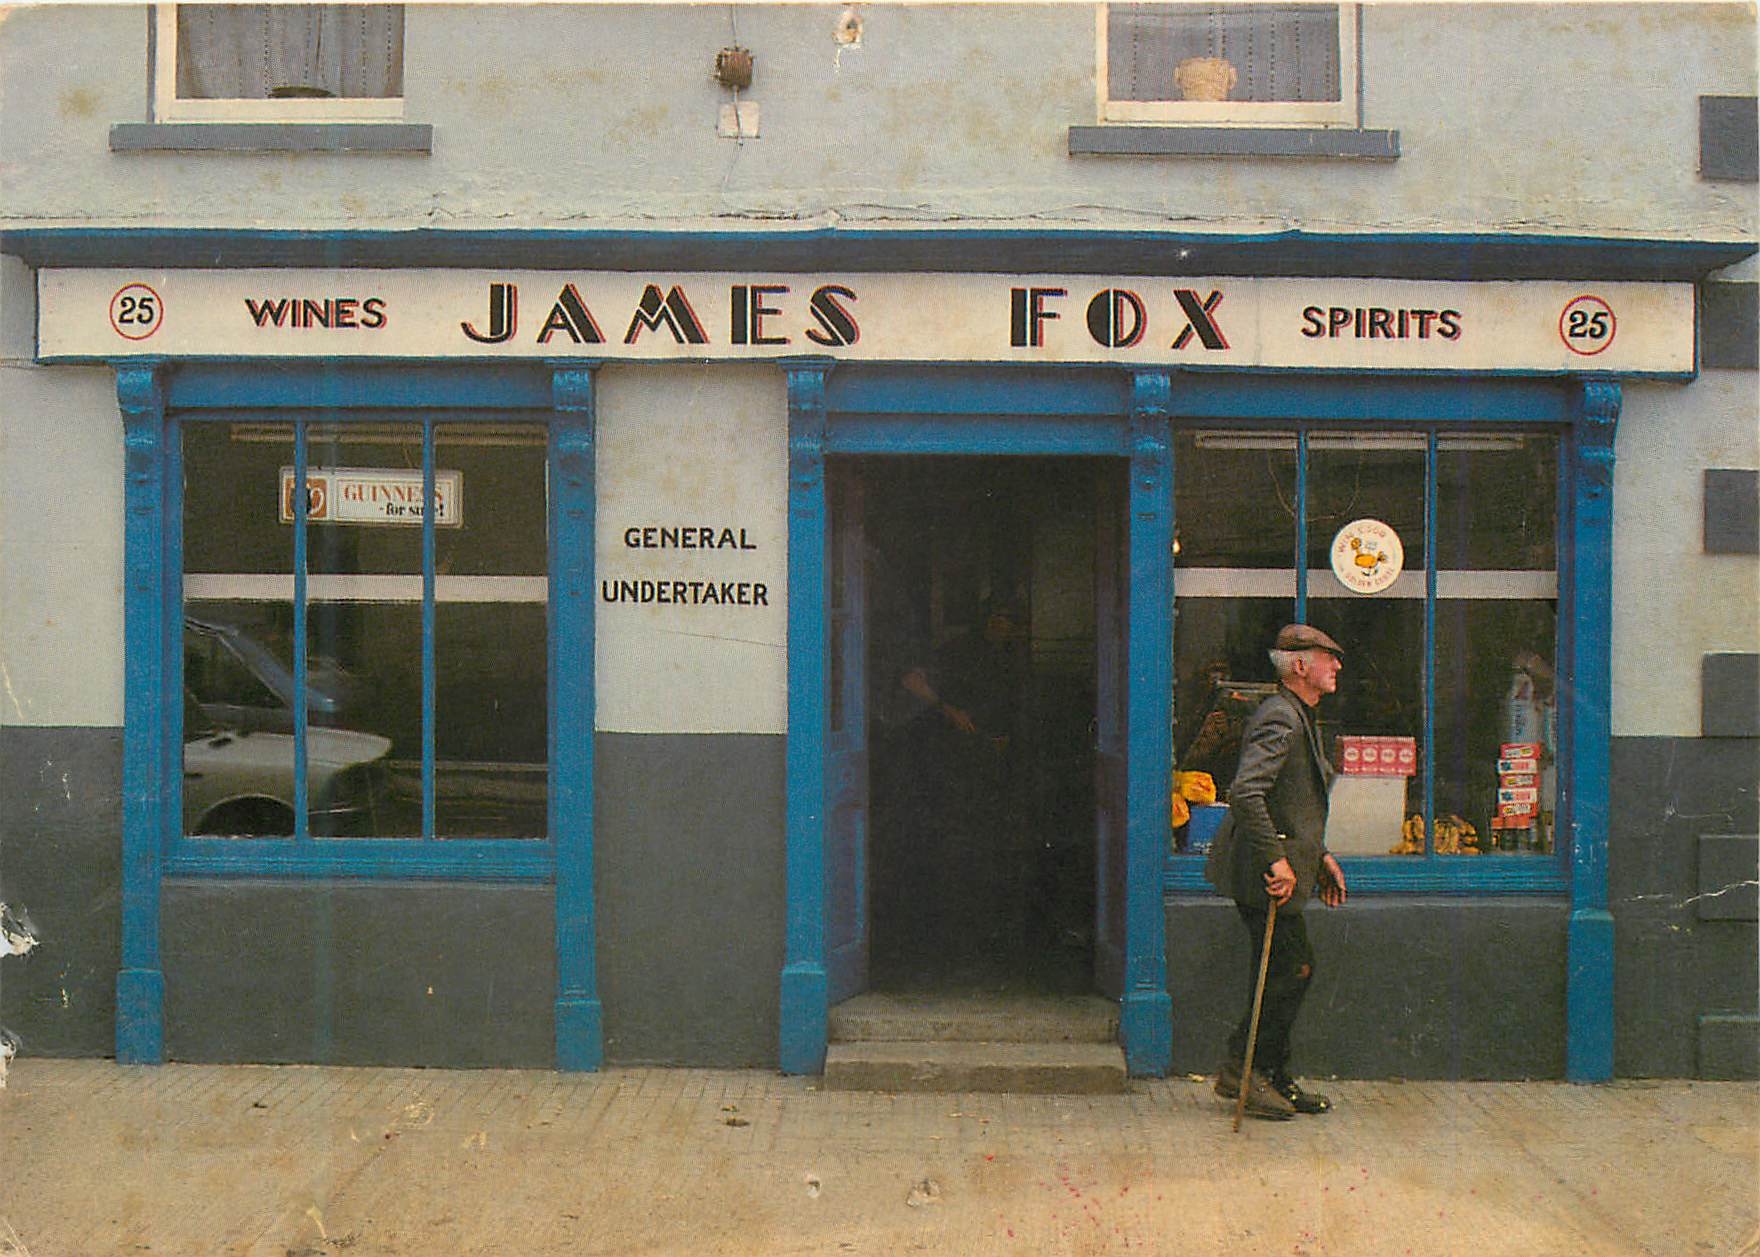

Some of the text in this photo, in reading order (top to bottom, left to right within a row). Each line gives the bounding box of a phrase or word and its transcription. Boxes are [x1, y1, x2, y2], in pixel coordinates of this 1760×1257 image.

[118, 296, 154, 325] 25
[245, 298, 387, 329] WINES
[461, 282, 1232, 351] JAMES FOX
[1301, 306, 1463, 341] SPIRITS
[1569, 309, 1610, 339] 25
[343, 484, 444, 502] GUINNES
[624, 527, 757, 549] GENERAL
[603, 580, 768, 606] UNDERTAKER
